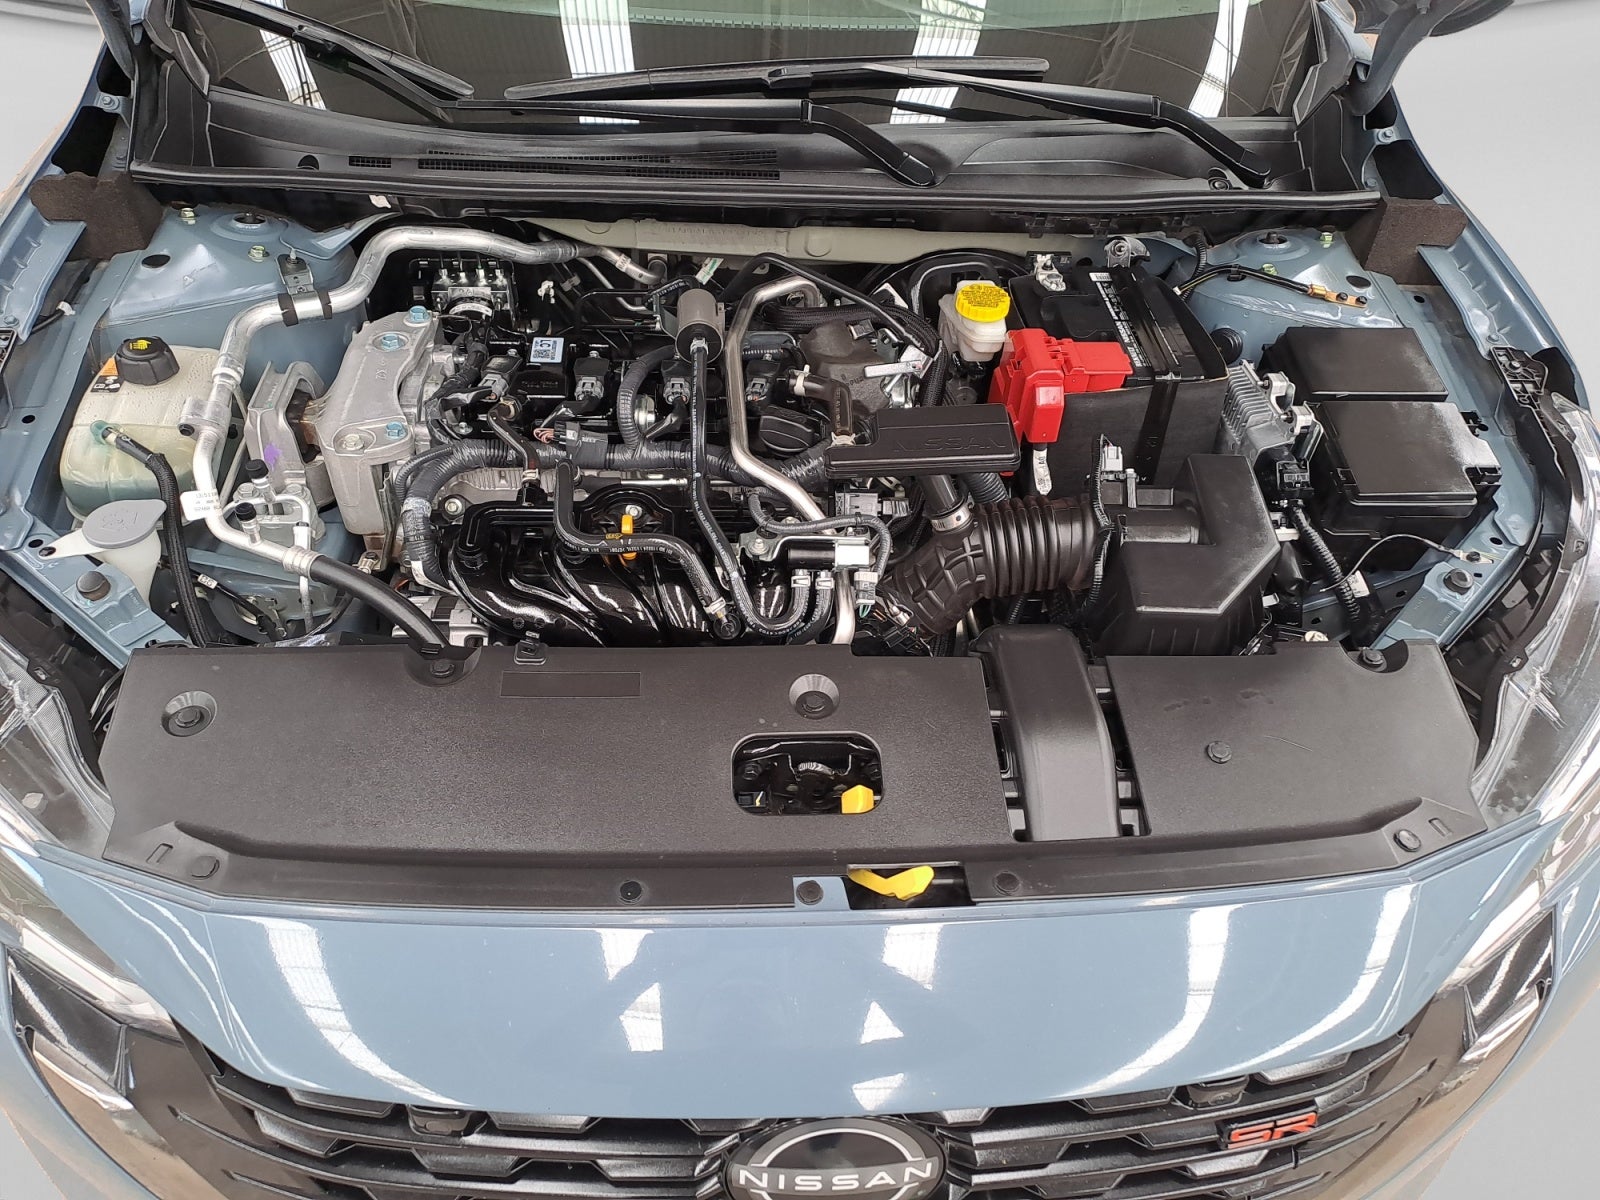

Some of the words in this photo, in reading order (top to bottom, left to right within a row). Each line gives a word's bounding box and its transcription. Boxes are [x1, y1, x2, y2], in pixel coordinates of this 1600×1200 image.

[892, 436, 1007, 453] NISSAN
[1227, 1112, 1318, 1149] SR
[739, 1162, 932, 1191] NISSAN
